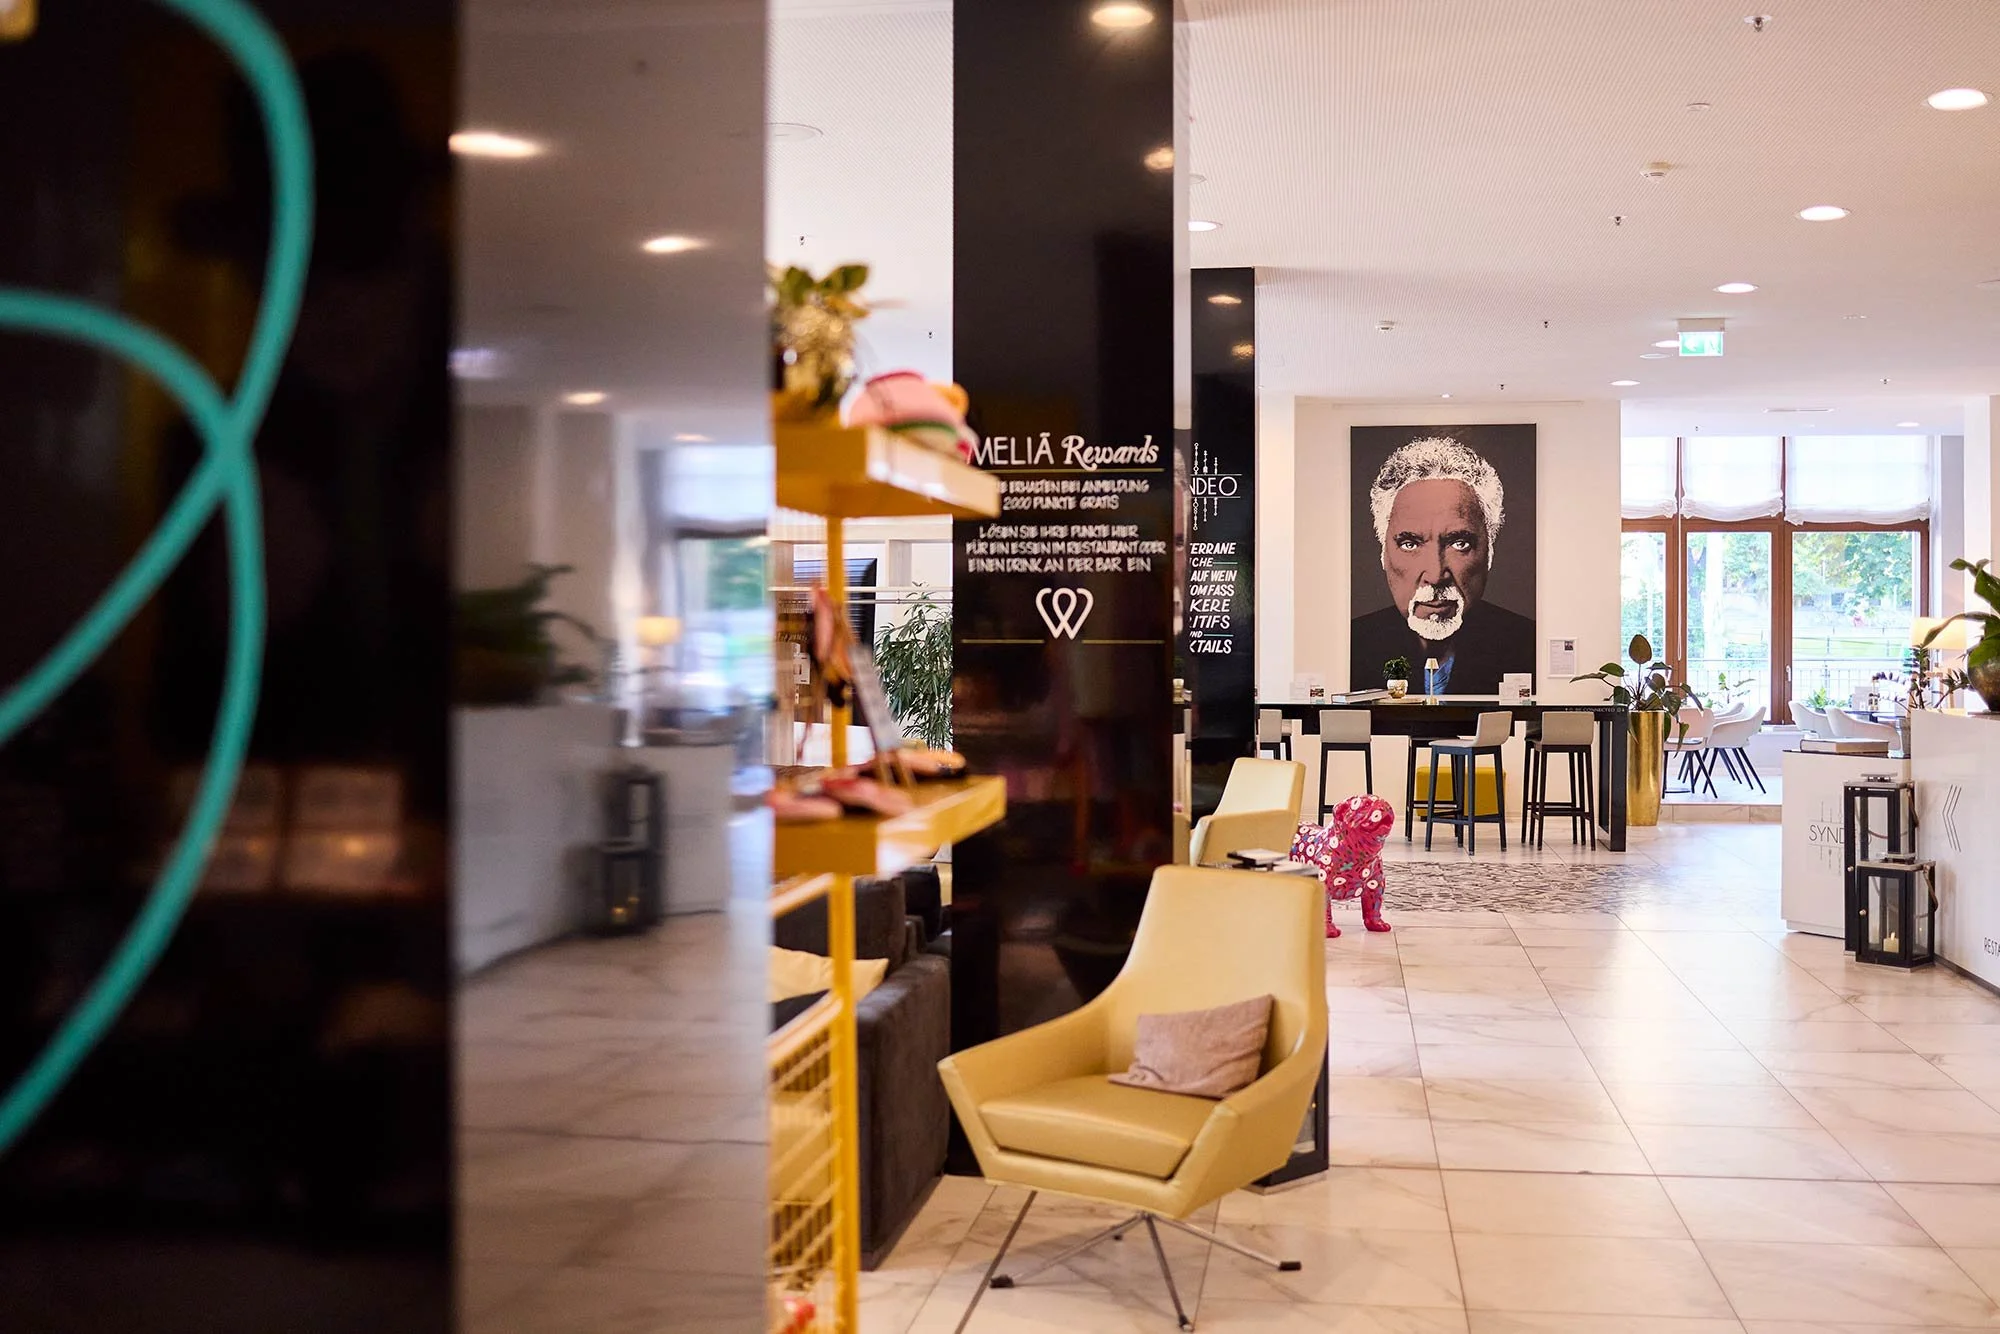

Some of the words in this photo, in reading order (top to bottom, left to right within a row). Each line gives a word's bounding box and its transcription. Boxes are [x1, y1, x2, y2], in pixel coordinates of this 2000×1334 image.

[1061, 434, 1160, 471] Rewards
[1081, 479, 1149, 493] ANMELDUNG
[1003, 496, 1032, 510] 2000
[1033, 496, 1077, 510] PUNKTE
[1080, 494, 1120, 510] GRATIS
[980, 523, 1019, 539] LÖSEN
[1070, 525, 1110, 538] PUNKTE
[1111, 525, 1139, 538] HIER
[966, 539, 988, 555] FÜR
[989, 541, 1010, 555] EIN
[1011, 541, 1051, 555] ESSEN
[1052, 541, 1066, 554] IM
[1067, 540, 1139, 555] RESTAURANT
[1139, 541, 1166, 555] ODER
[1190, 542, 1237, 555] ERRANE
[968, 557, 1005, 573] EINEN
[1006, 557, 1042, 572] DRINK
[1043, 557, 1064, 572] AN
[1067, 557, 1095, 573] DER
[1095, 557, 1122, 572] BAR
[1127, 557, 1151, 572] EIN
[1190, 557, 1214, 567] CHE
[1190, 570, 1210, 582] AUF
[1210, 570, 1238, 582] WEIN
[1190, 584, 1208, 596] OM
[1207, 584, 1235, 597] FASS
[1190, 615, 1231, 630] ITIFS
